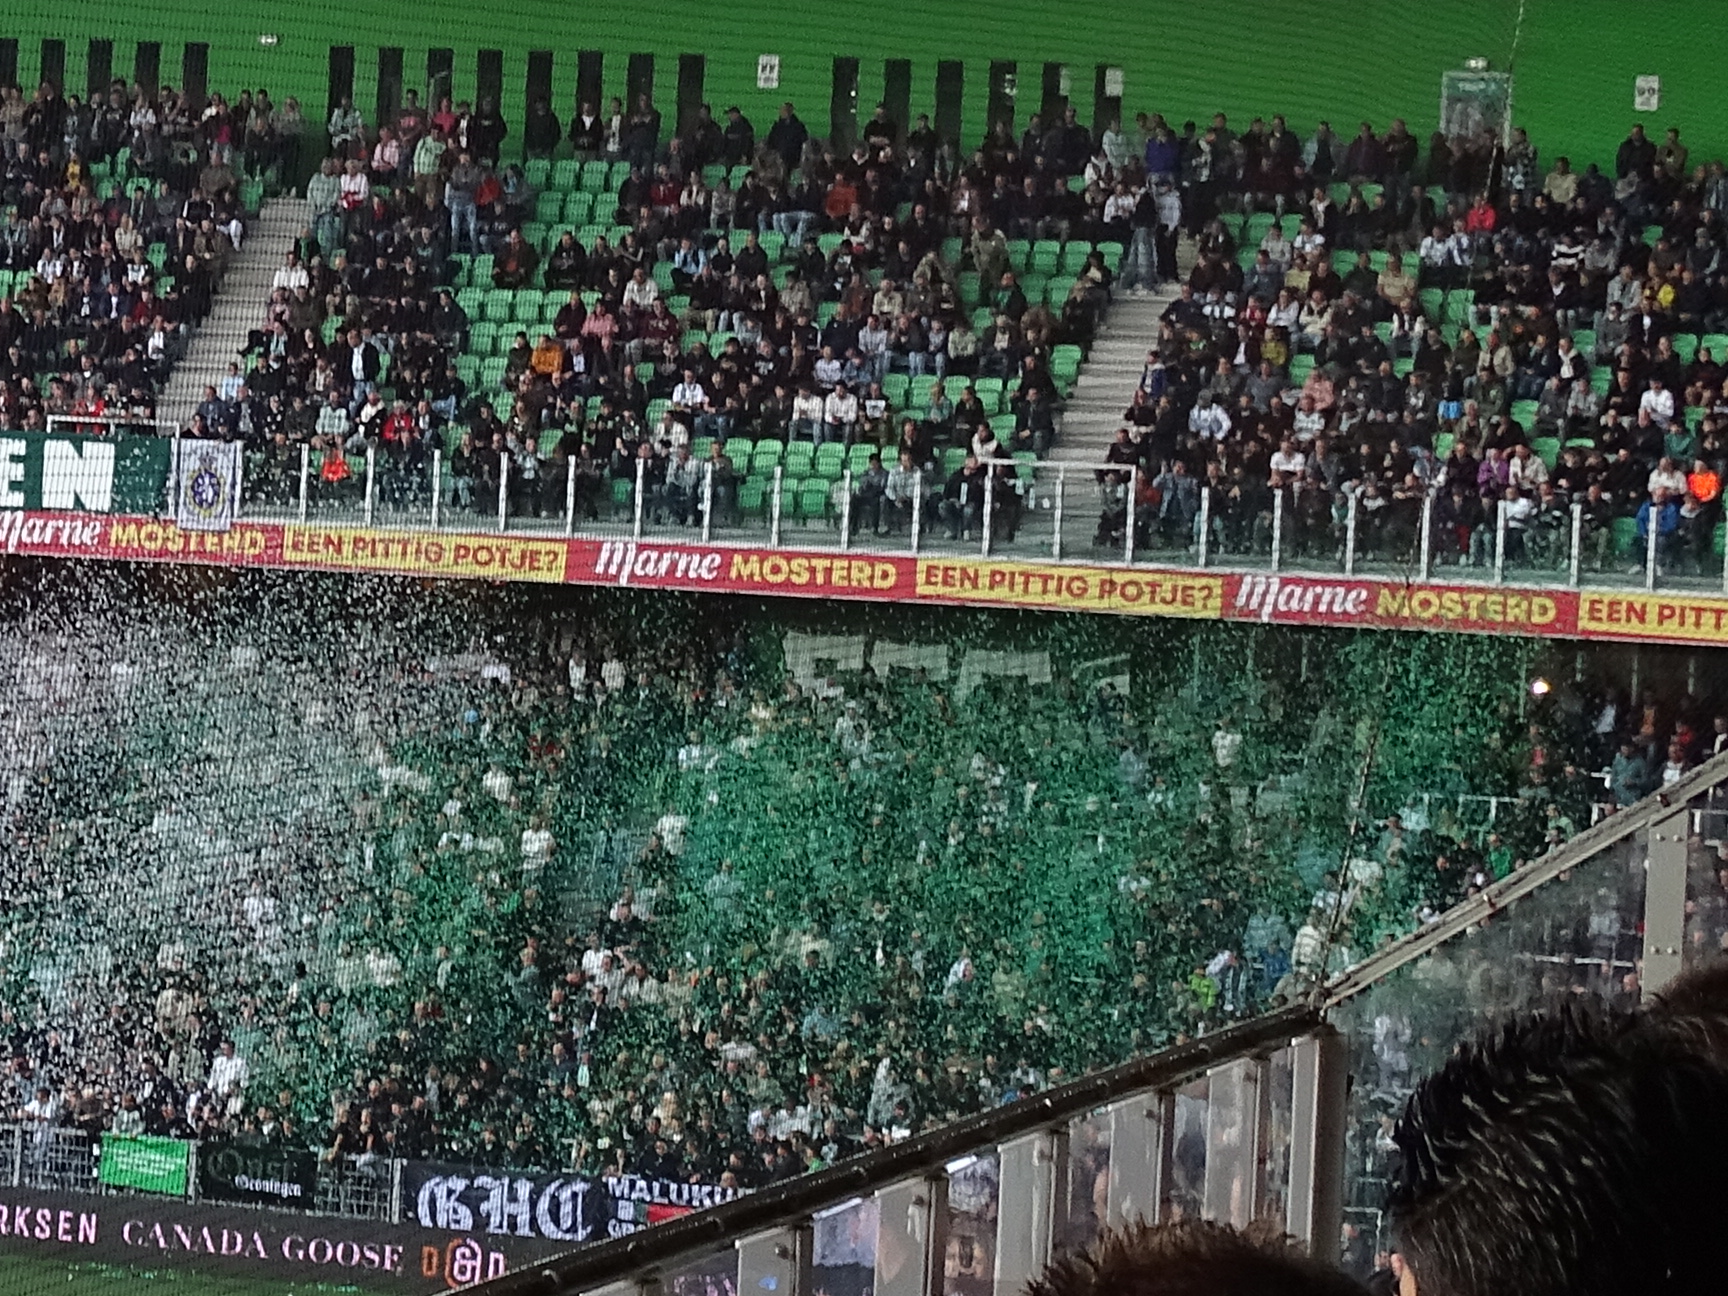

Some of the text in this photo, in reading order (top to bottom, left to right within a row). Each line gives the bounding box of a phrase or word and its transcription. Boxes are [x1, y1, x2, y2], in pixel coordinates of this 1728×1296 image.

[109, 520, 266, 556] MOSTERD
[290, 531, 560, 573] EEN PITTIG POTJE?
[594, 541, 898, 590] Marne MOSTERD
[923, 565, 1215, 609] EEN PITTIG POTJE?
[1233, 575, 1557, 626] Marne MOSTERD
[1588, 600, 1648, 624] EEN
[121, 1218, 404, 1272] CANADA GOOSE
